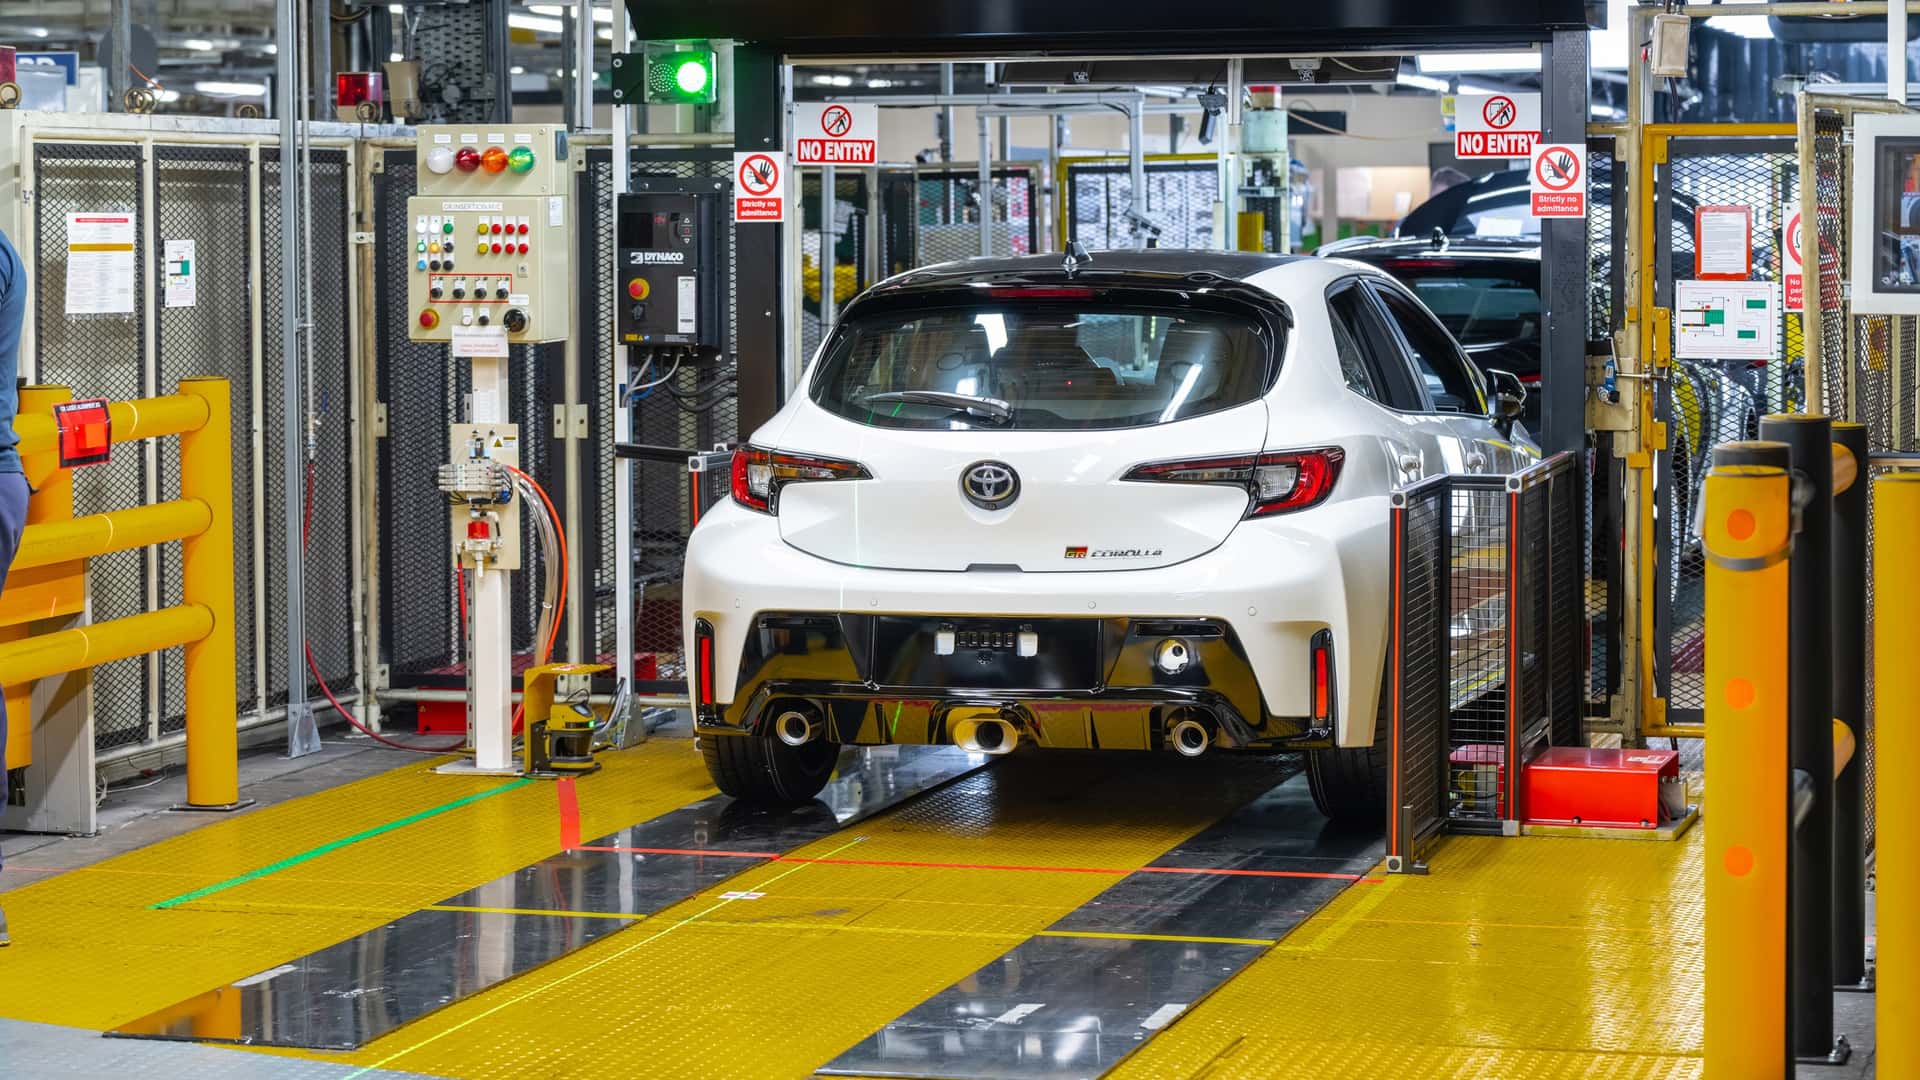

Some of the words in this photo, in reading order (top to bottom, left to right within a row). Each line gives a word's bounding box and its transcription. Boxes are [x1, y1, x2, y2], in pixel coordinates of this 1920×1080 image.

[1460, 134, 1483, 153] NO
[1487, 134, 1539, 153] ENTRY
[800, 141, 822, 160] NO
[825, 141, 873, 160] ENTRY
[742, 200, 766, 208] Strictly
[1538, 196, 1565, 204] Strictly
[1536, 204, 1579, 212] admittance
[644, 252, 684, 261] DYNACO
[1091, 549, 1162, 557] COROLLA
